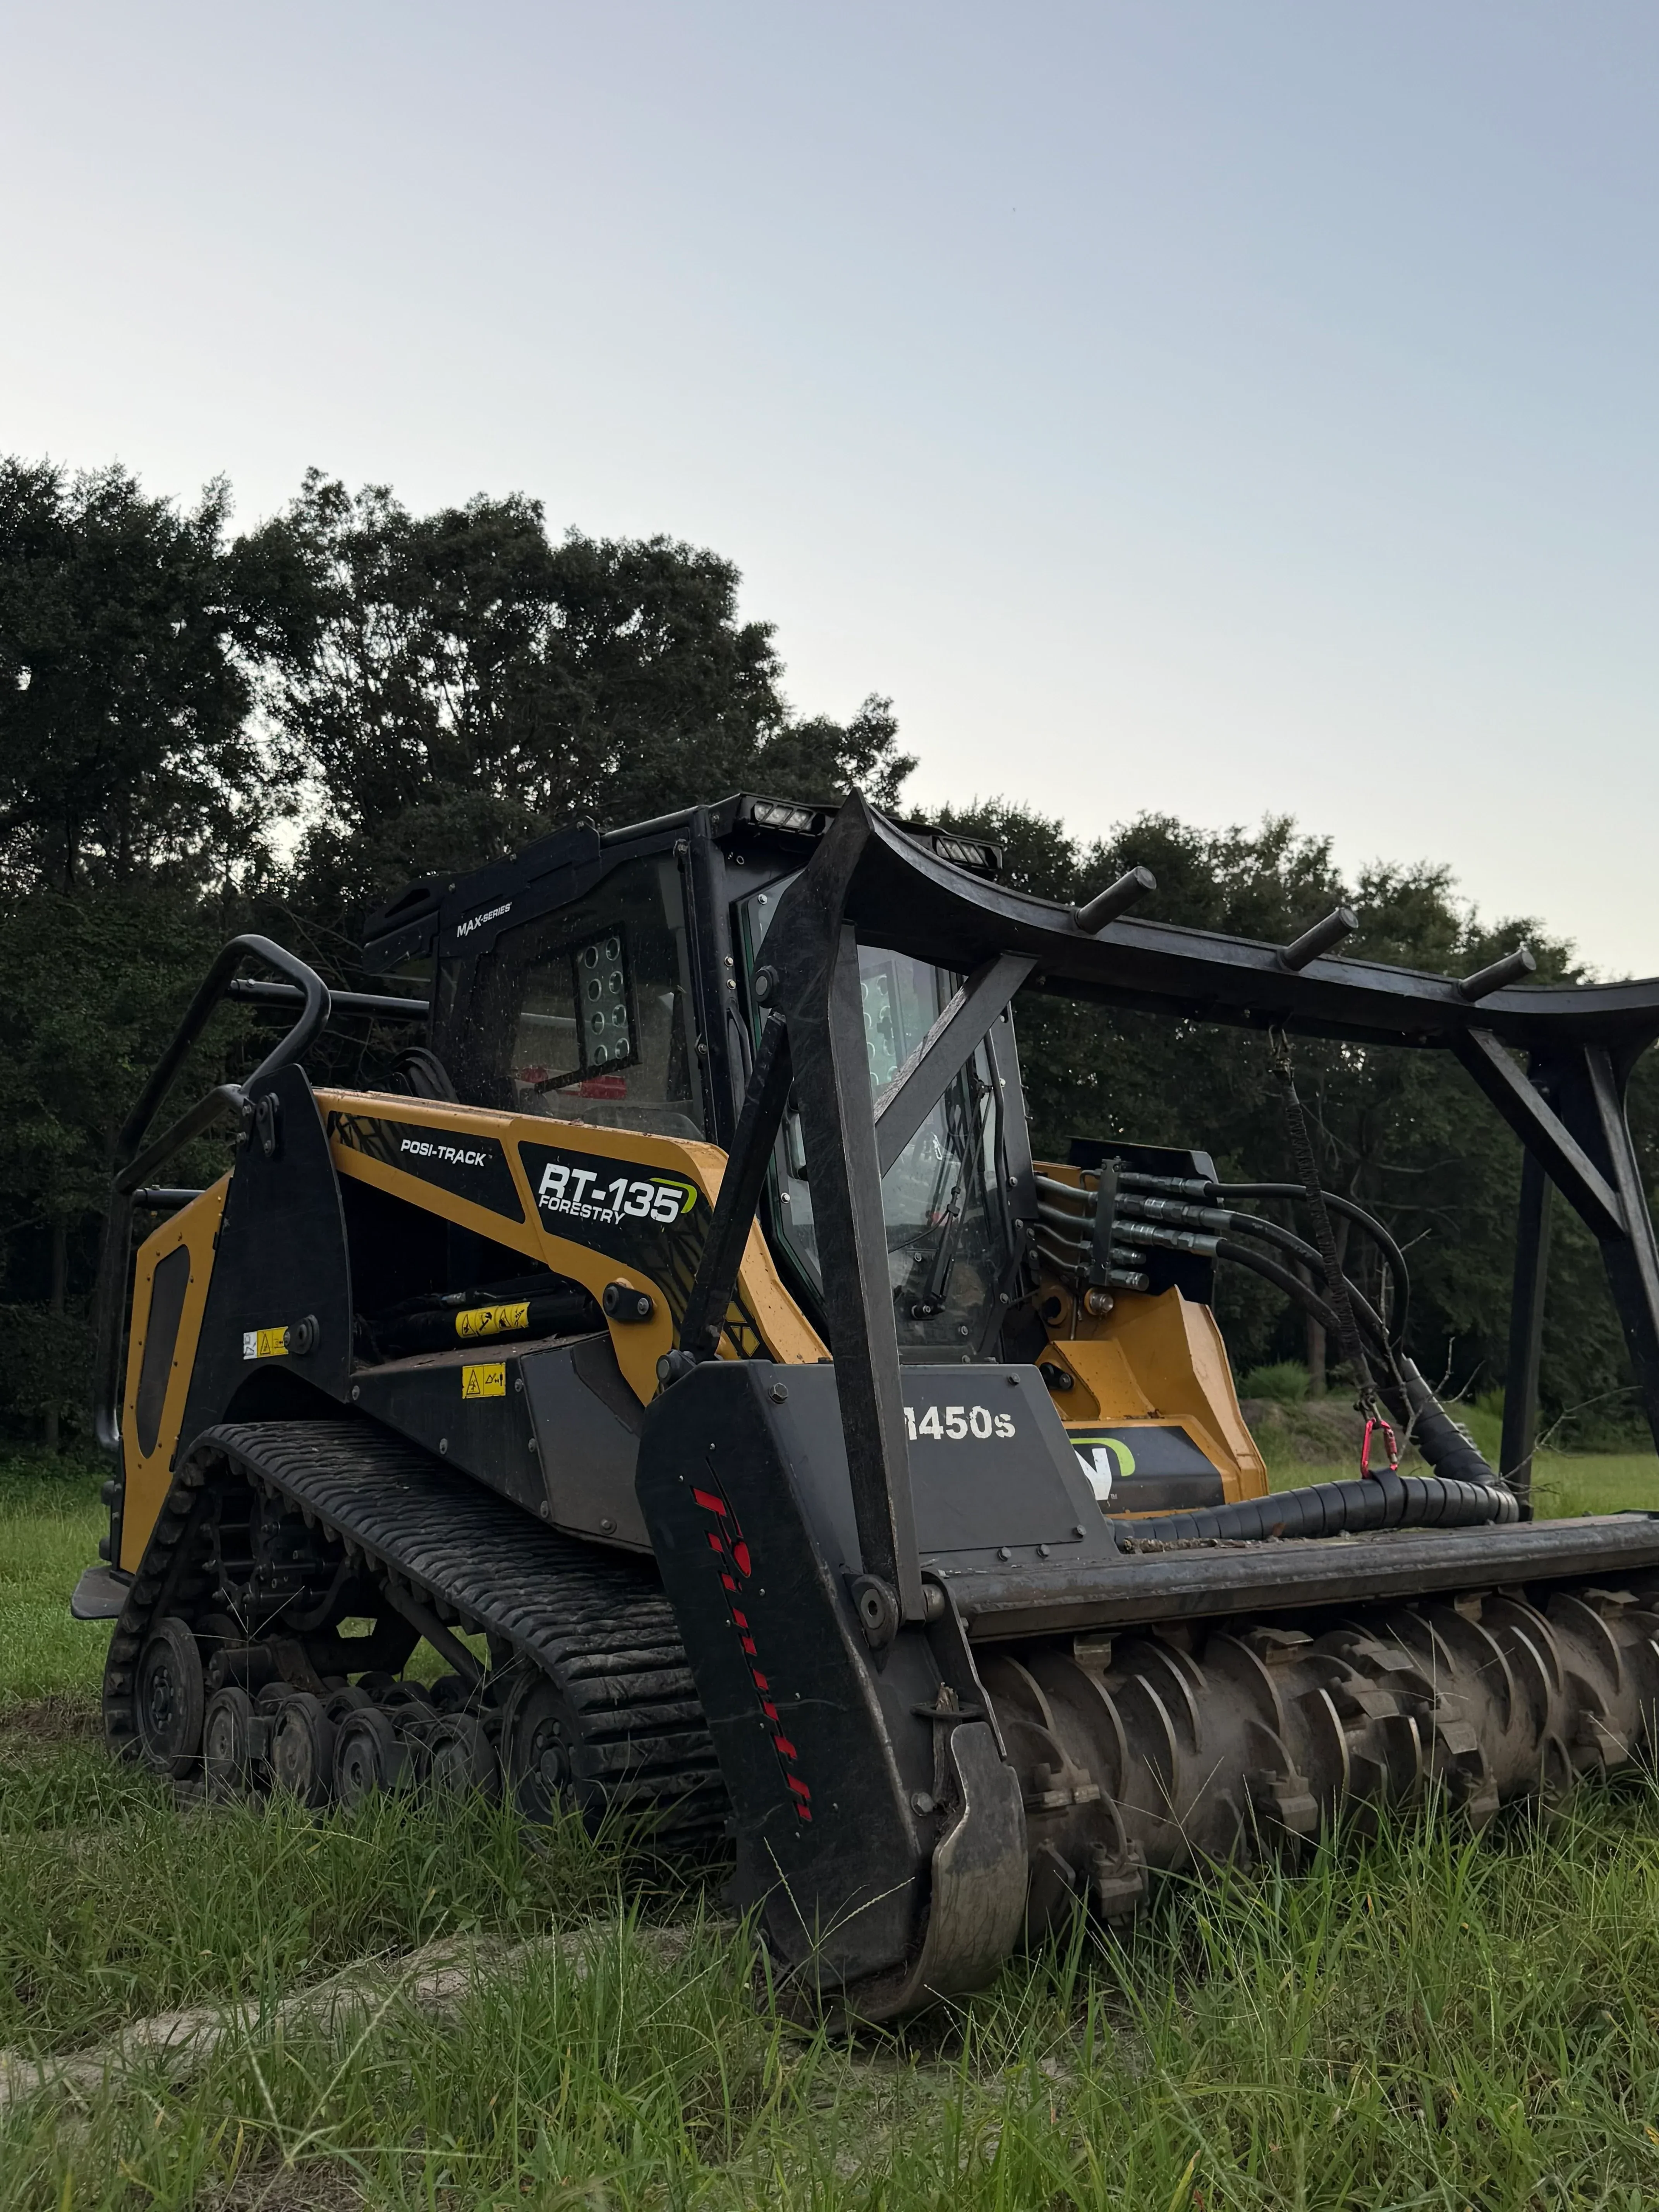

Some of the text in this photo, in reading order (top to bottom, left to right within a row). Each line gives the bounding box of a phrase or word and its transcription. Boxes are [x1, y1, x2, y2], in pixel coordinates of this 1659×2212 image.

[400, 1139, 487, 1167] POSI-TRACK
[538, 1163, 683, 1224] RT-135
[538, 1195, 626, 1225] FORESTRY
